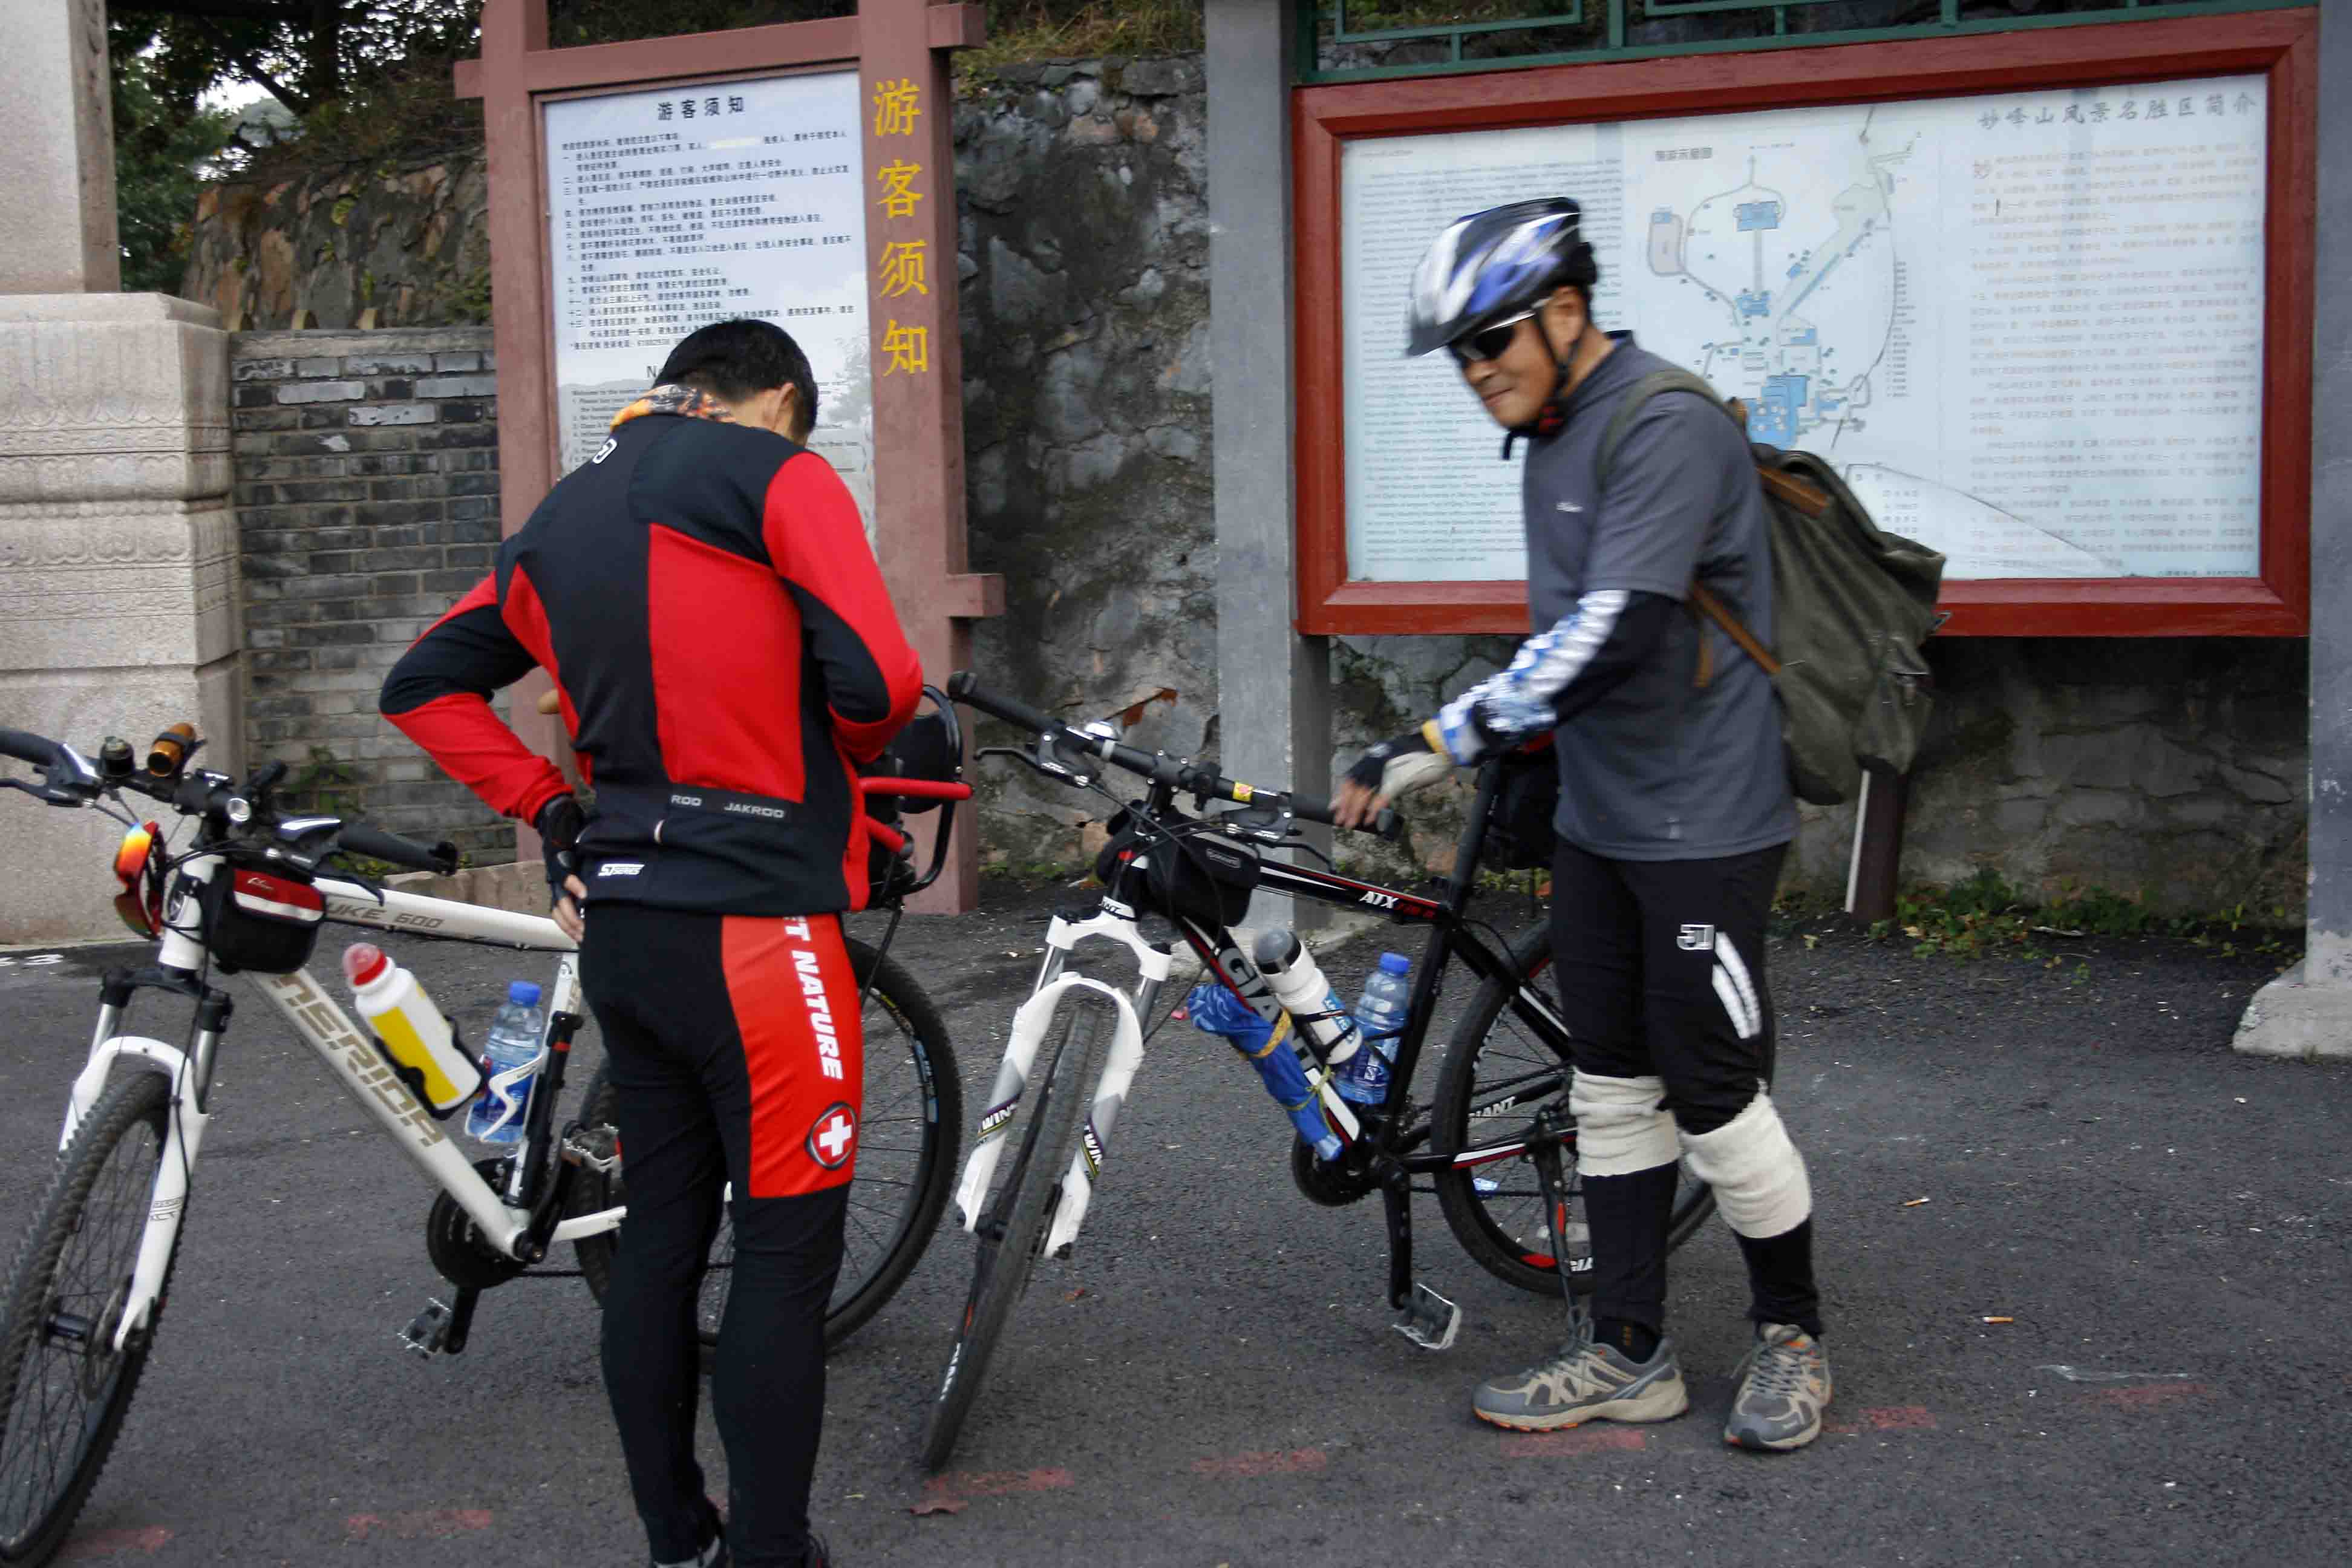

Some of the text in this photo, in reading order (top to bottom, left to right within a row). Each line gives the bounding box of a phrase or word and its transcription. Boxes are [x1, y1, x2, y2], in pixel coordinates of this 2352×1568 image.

[658, 95, 743, 121] 游客须知
[872, 77, 929, 377] 游客须知
[724, 803, 785, 818] JAKROO
[1359, 890, 1399, 909] ATX
[395, 913, 446, 929] 600
[791, 950, 843, 1080] NATURE
